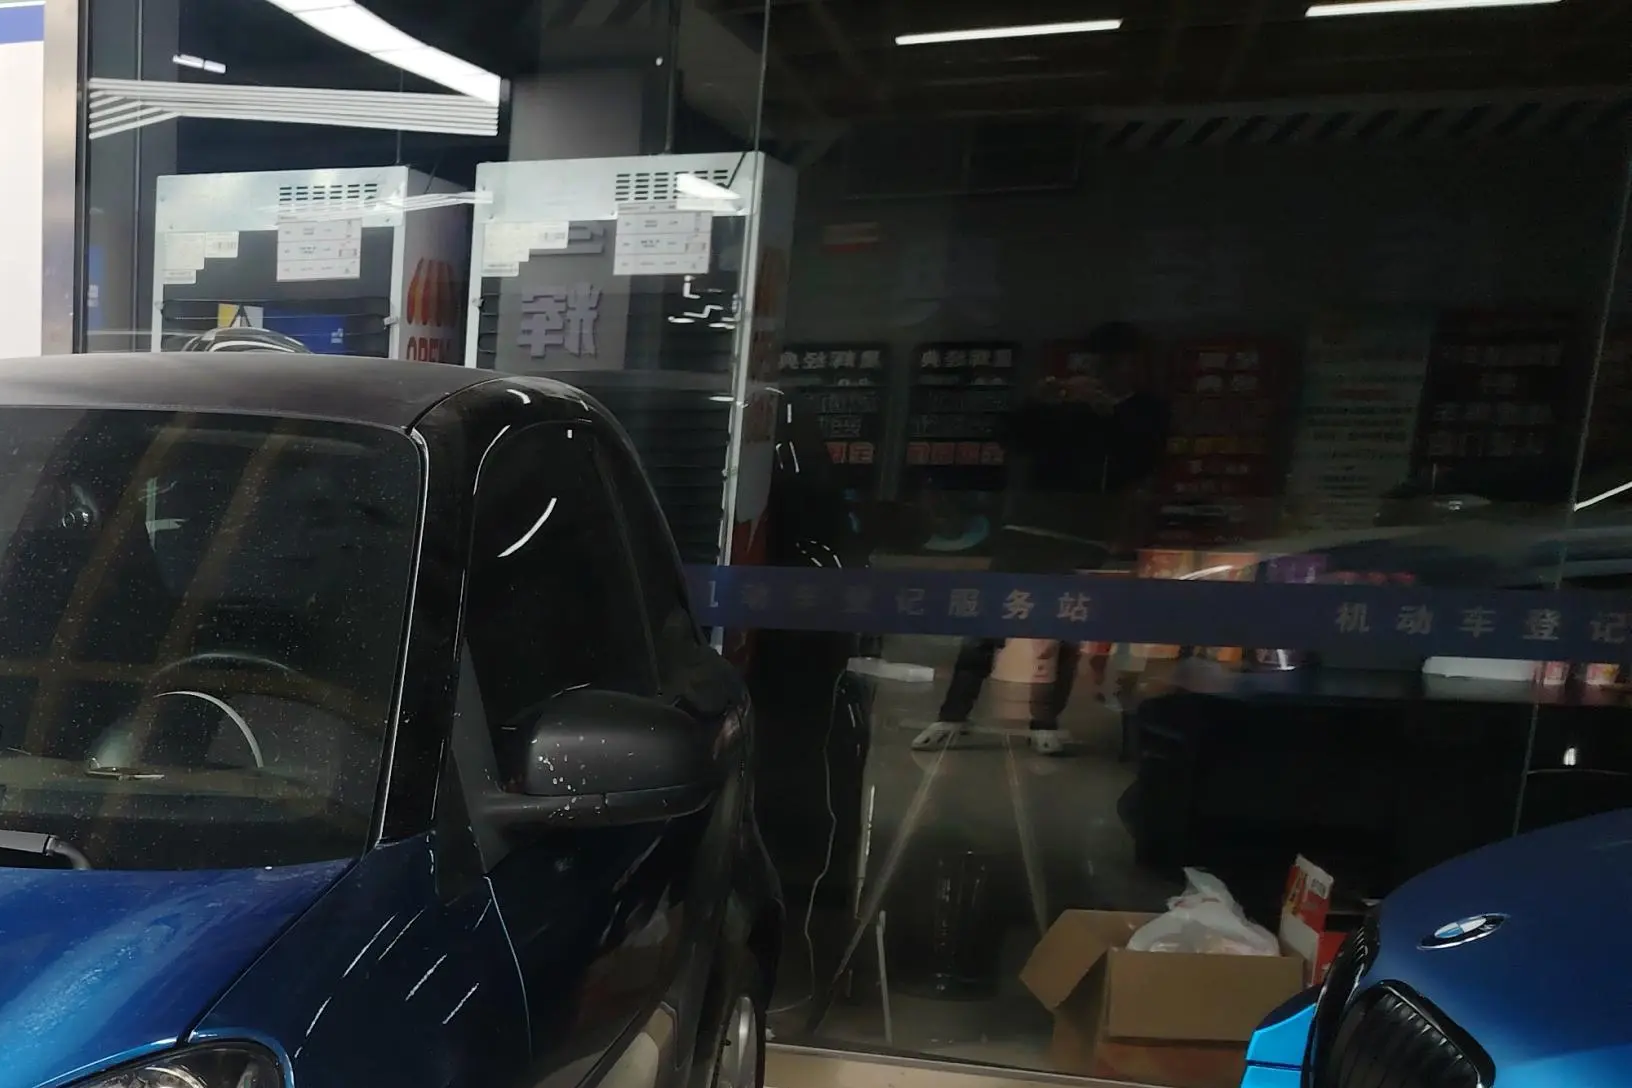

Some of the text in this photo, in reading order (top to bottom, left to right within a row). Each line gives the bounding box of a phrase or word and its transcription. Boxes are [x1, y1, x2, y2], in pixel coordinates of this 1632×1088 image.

[1335, 601, 1628, 645] 机动车登记
